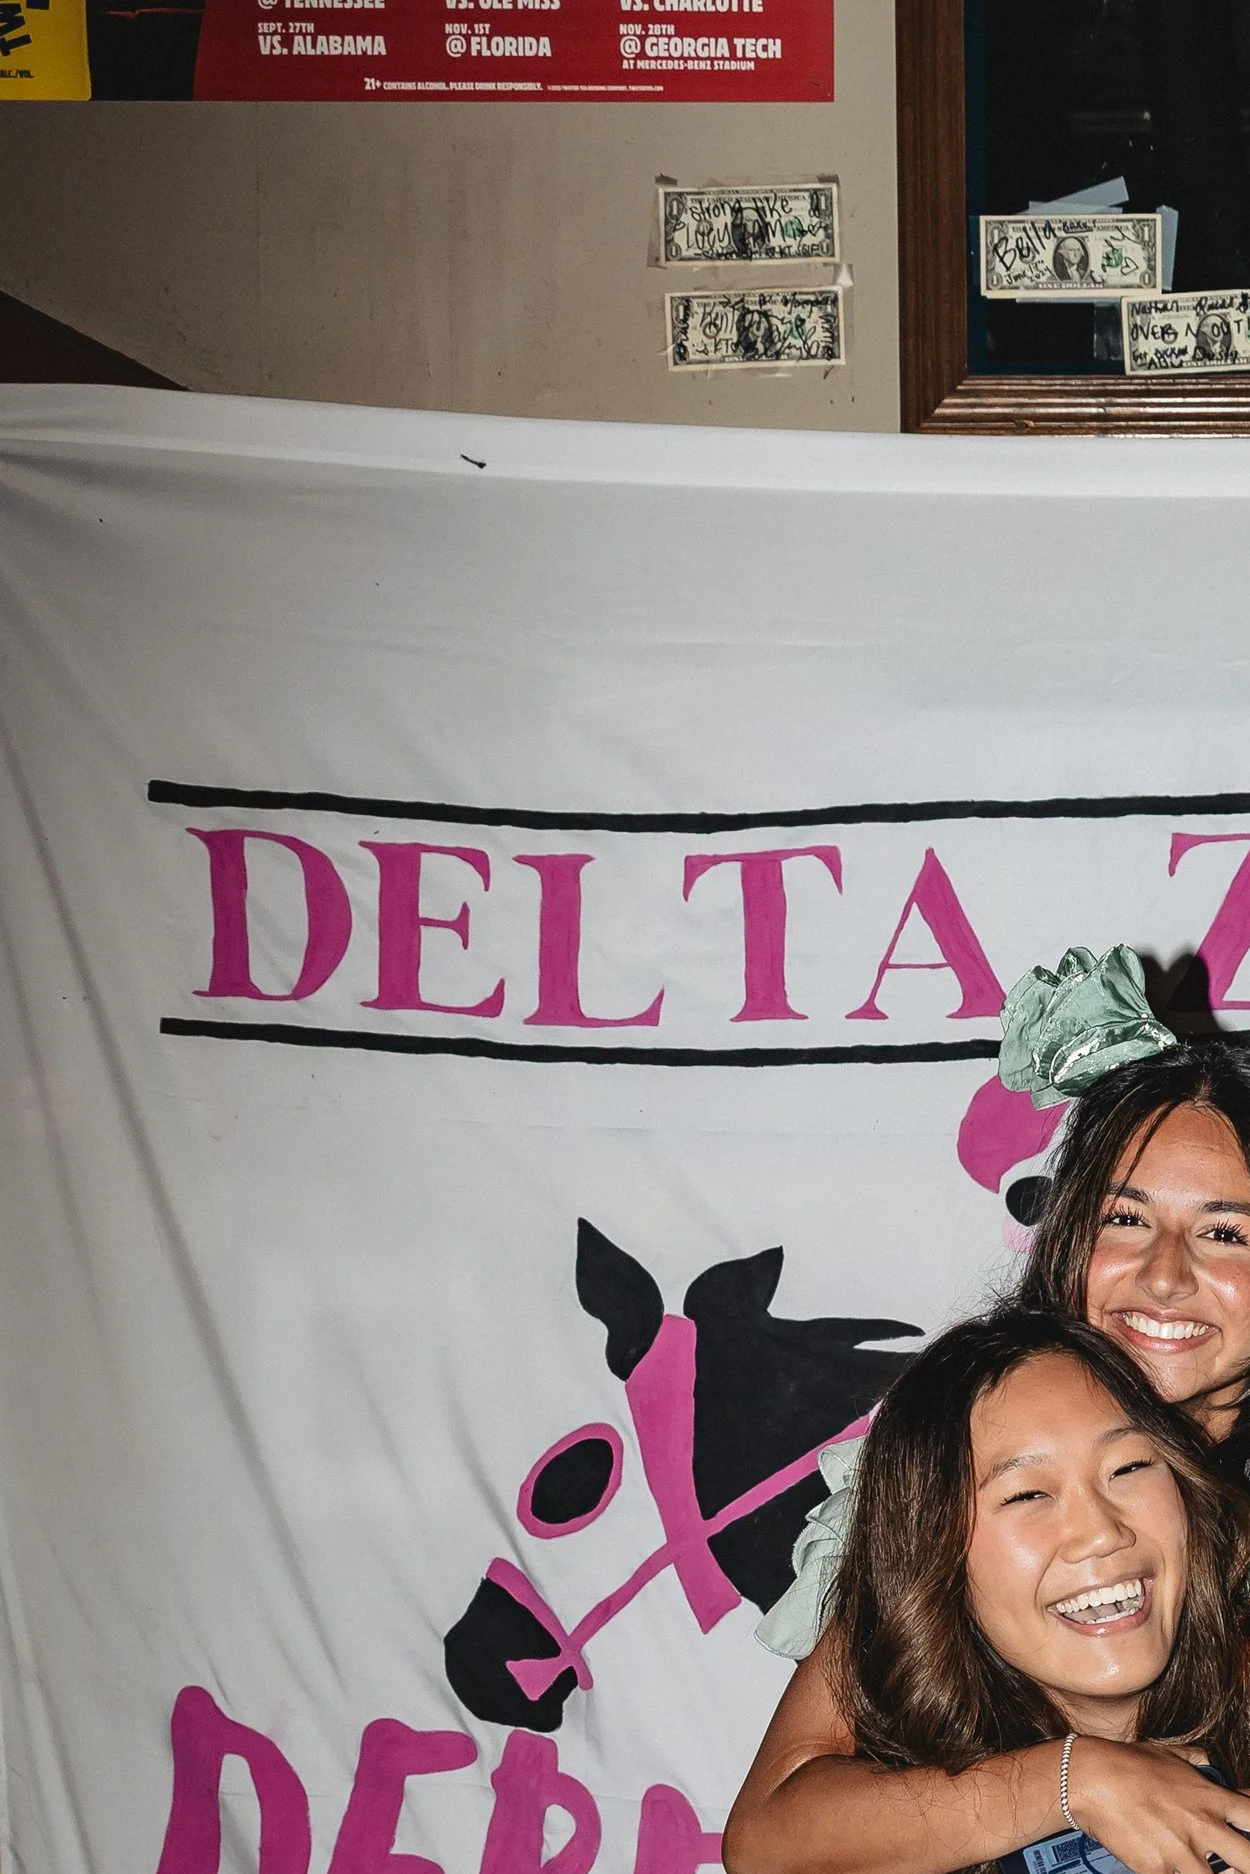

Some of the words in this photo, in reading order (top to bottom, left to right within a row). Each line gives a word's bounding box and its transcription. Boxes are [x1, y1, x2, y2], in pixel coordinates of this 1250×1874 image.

[258, 23, 285, 33] SEPT.
[289, 23, 314, 33] 27TH
[445, 24, 471, 34] NOV.
[474, 24, 491, 34] 1ST
[619, 24, 645, 35] NOV.
[648, 24, 674, 35] 28TH
[258, 36, 288, 55] VS.
[292, 36, 387, 56] ALABAMA
[446, 36, 466, 57] @
[471, 37, 552, 57] FLORIDA
[620, 36, 641, 58] @
[645, 37, 730, 57] GEORGIA
[734, 38, 782, 59] TECH
[622, 60, 635, 69] AT
[637, 60, 711, 70] MERCEDES-BENZ
[714, 60, 755, 70] STADIUM
[364, 78, 381, 90] 21+
[993, 219, 1058, 272] Bella
[186, 826, 1007, 1028] DELTA
